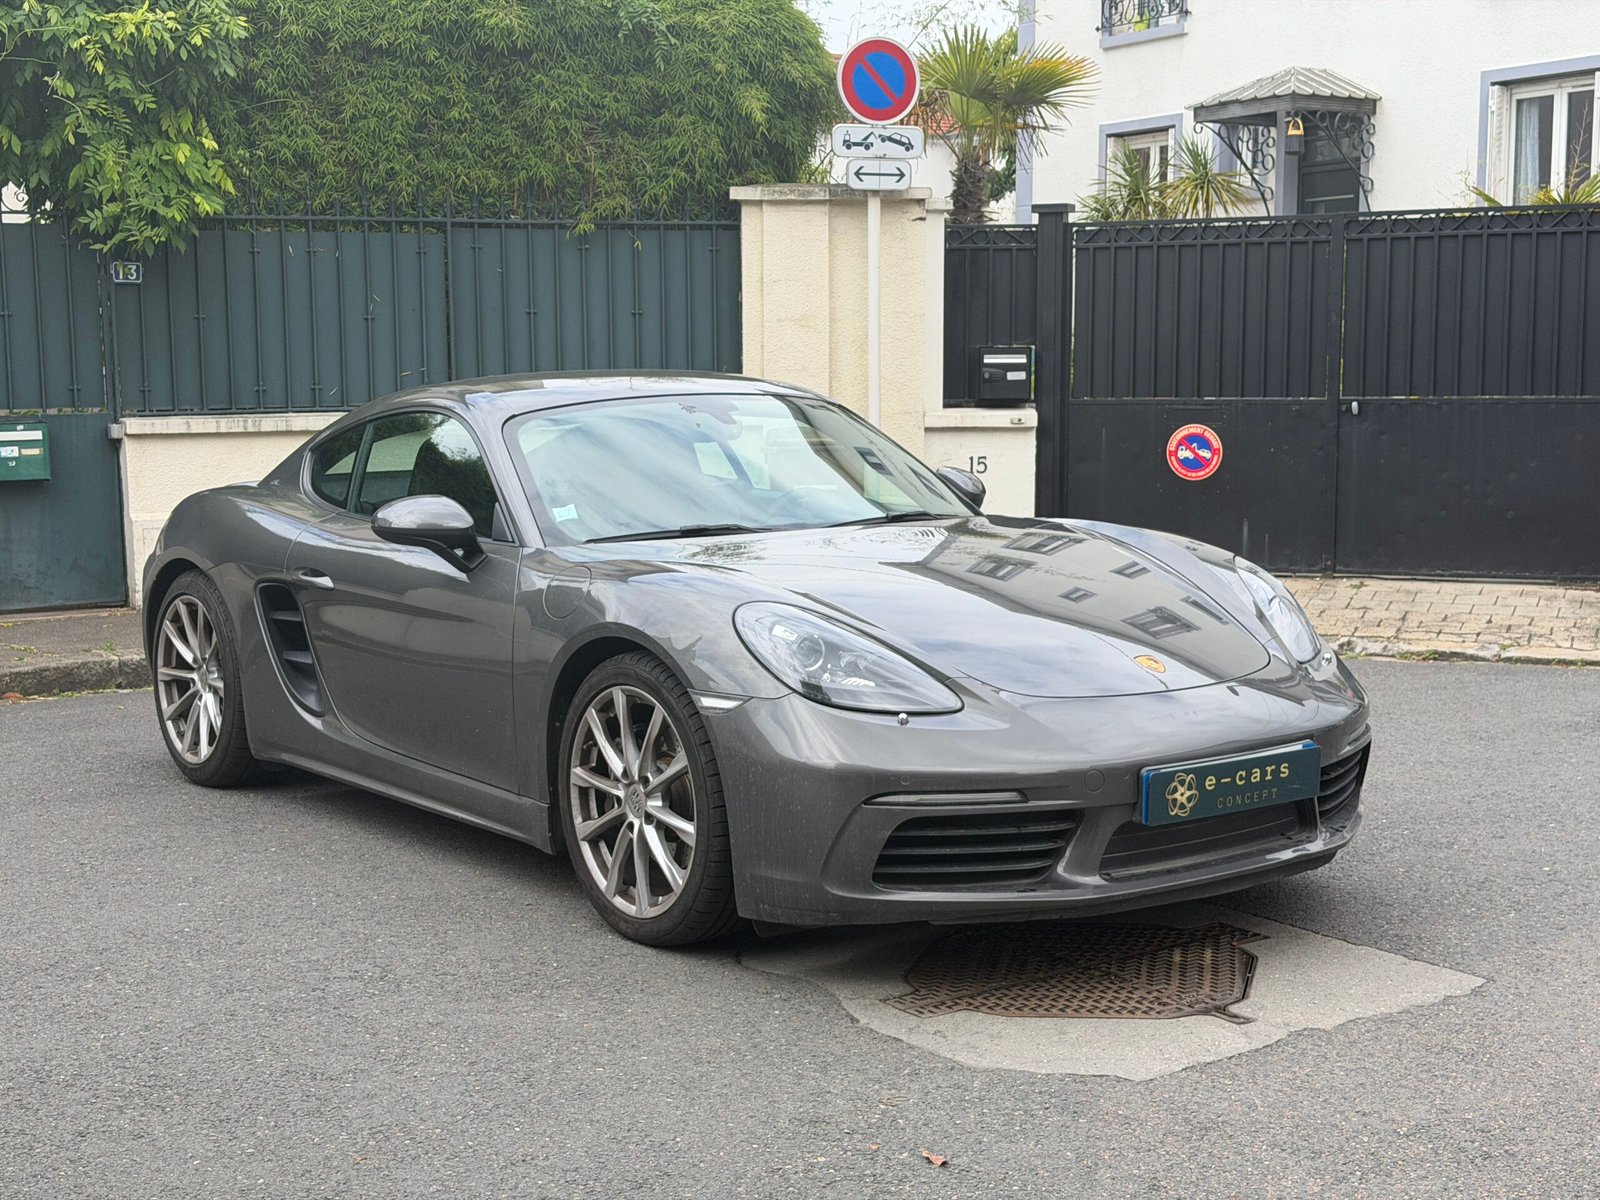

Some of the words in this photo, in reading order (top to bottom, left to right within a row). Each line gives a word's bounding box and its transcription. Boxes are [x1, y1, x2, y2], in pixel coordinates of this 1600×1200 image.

[118, 264, 137, 280] 13
[968, 455, 988, 475] 15
[1204, 762, 1290, 791] e-cars
[1216, 787, 1278, 808] CONCEPT
